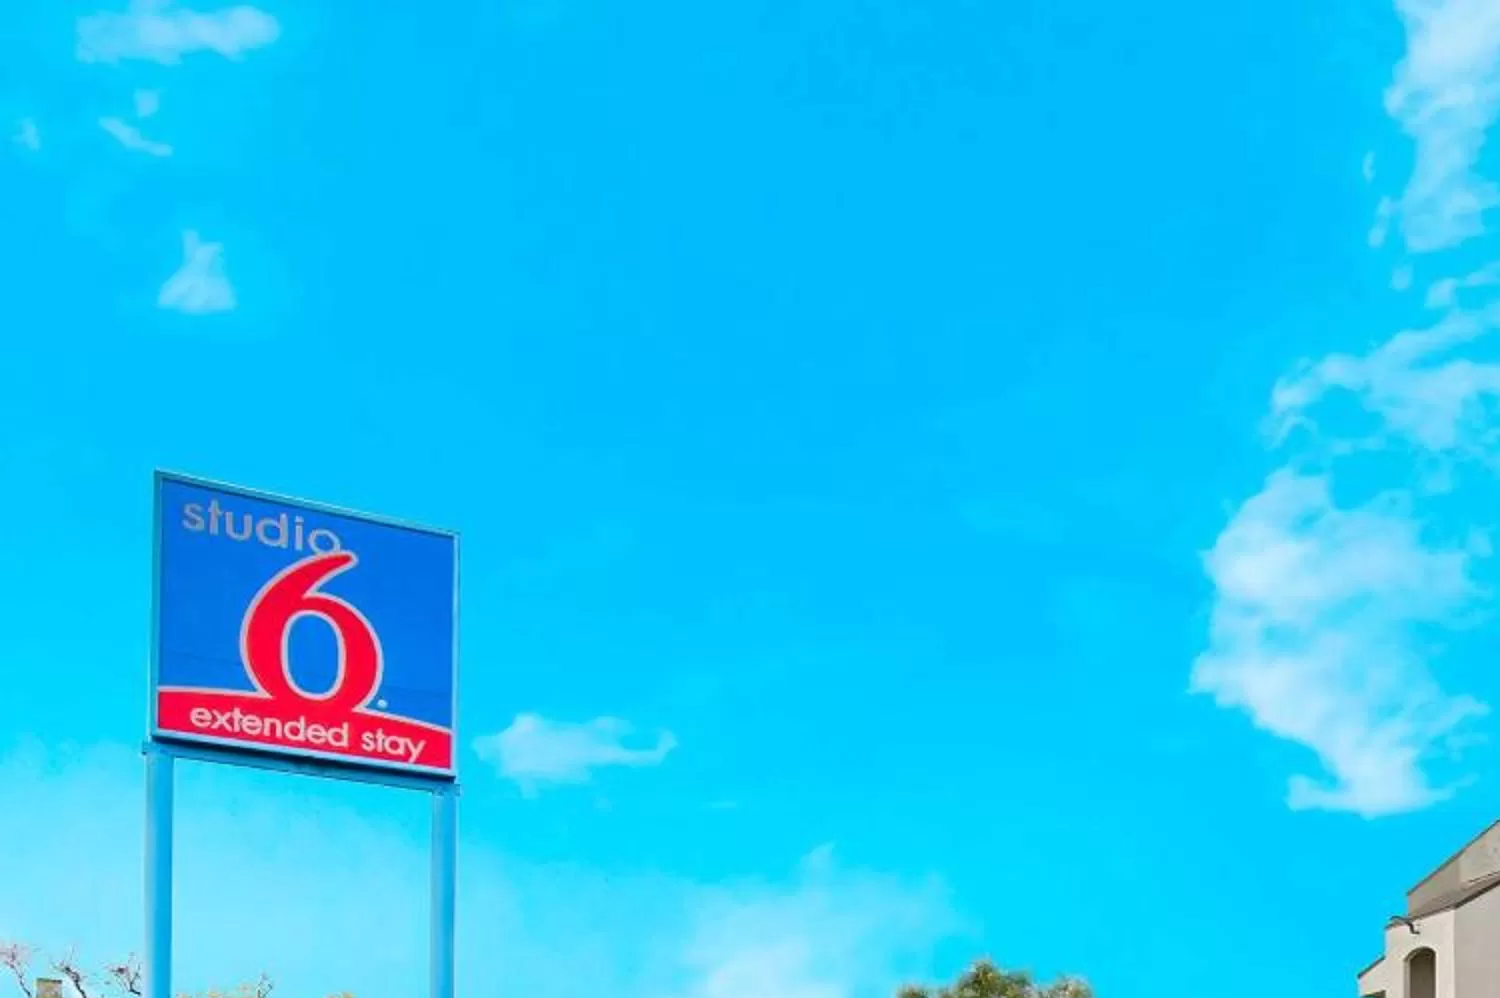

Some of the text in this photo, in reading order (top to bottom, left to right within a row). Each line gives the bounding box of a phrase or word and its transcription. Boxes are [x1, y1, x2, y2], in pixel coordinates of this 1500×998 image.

[182, 499, 341, 555] studio
[239, 550, 384, 711] 6
[189, 706, 425, 763] extended stay
